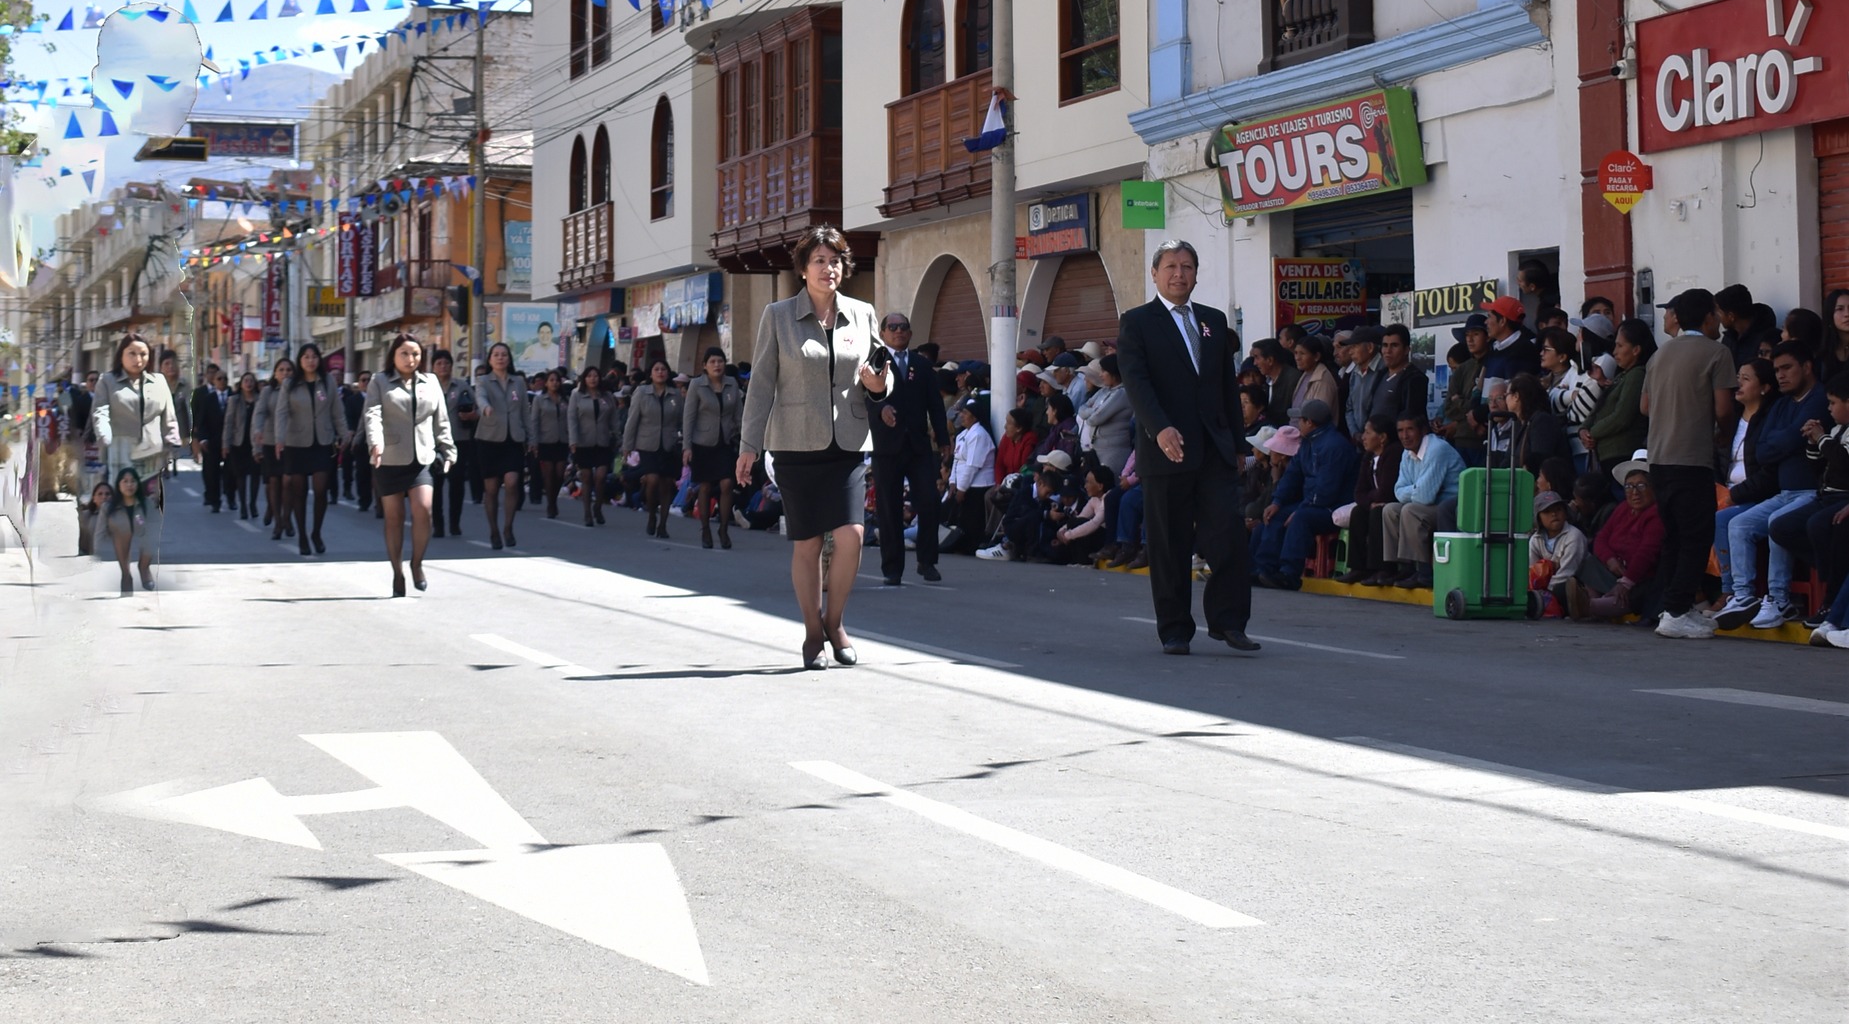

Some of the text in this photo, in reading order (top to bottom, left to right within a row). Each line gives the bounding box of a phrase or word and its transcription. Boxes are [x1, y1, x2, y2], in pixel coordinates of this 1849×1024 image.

[1656, 48, 1798, 132] Claro
[1235, 107, 1353, 144] AGENCIA DE VIAJES Y TURISMO
[1218, 124, 1369, 200] TOURS
[1608, 163, 1632, 173] Claro
[1279, 265, 1338, 276] VENTA DE
[1279, 280, 1361, 300] CELULARES
[1299, 303, 1362, 314] Y REPARACIÓN
